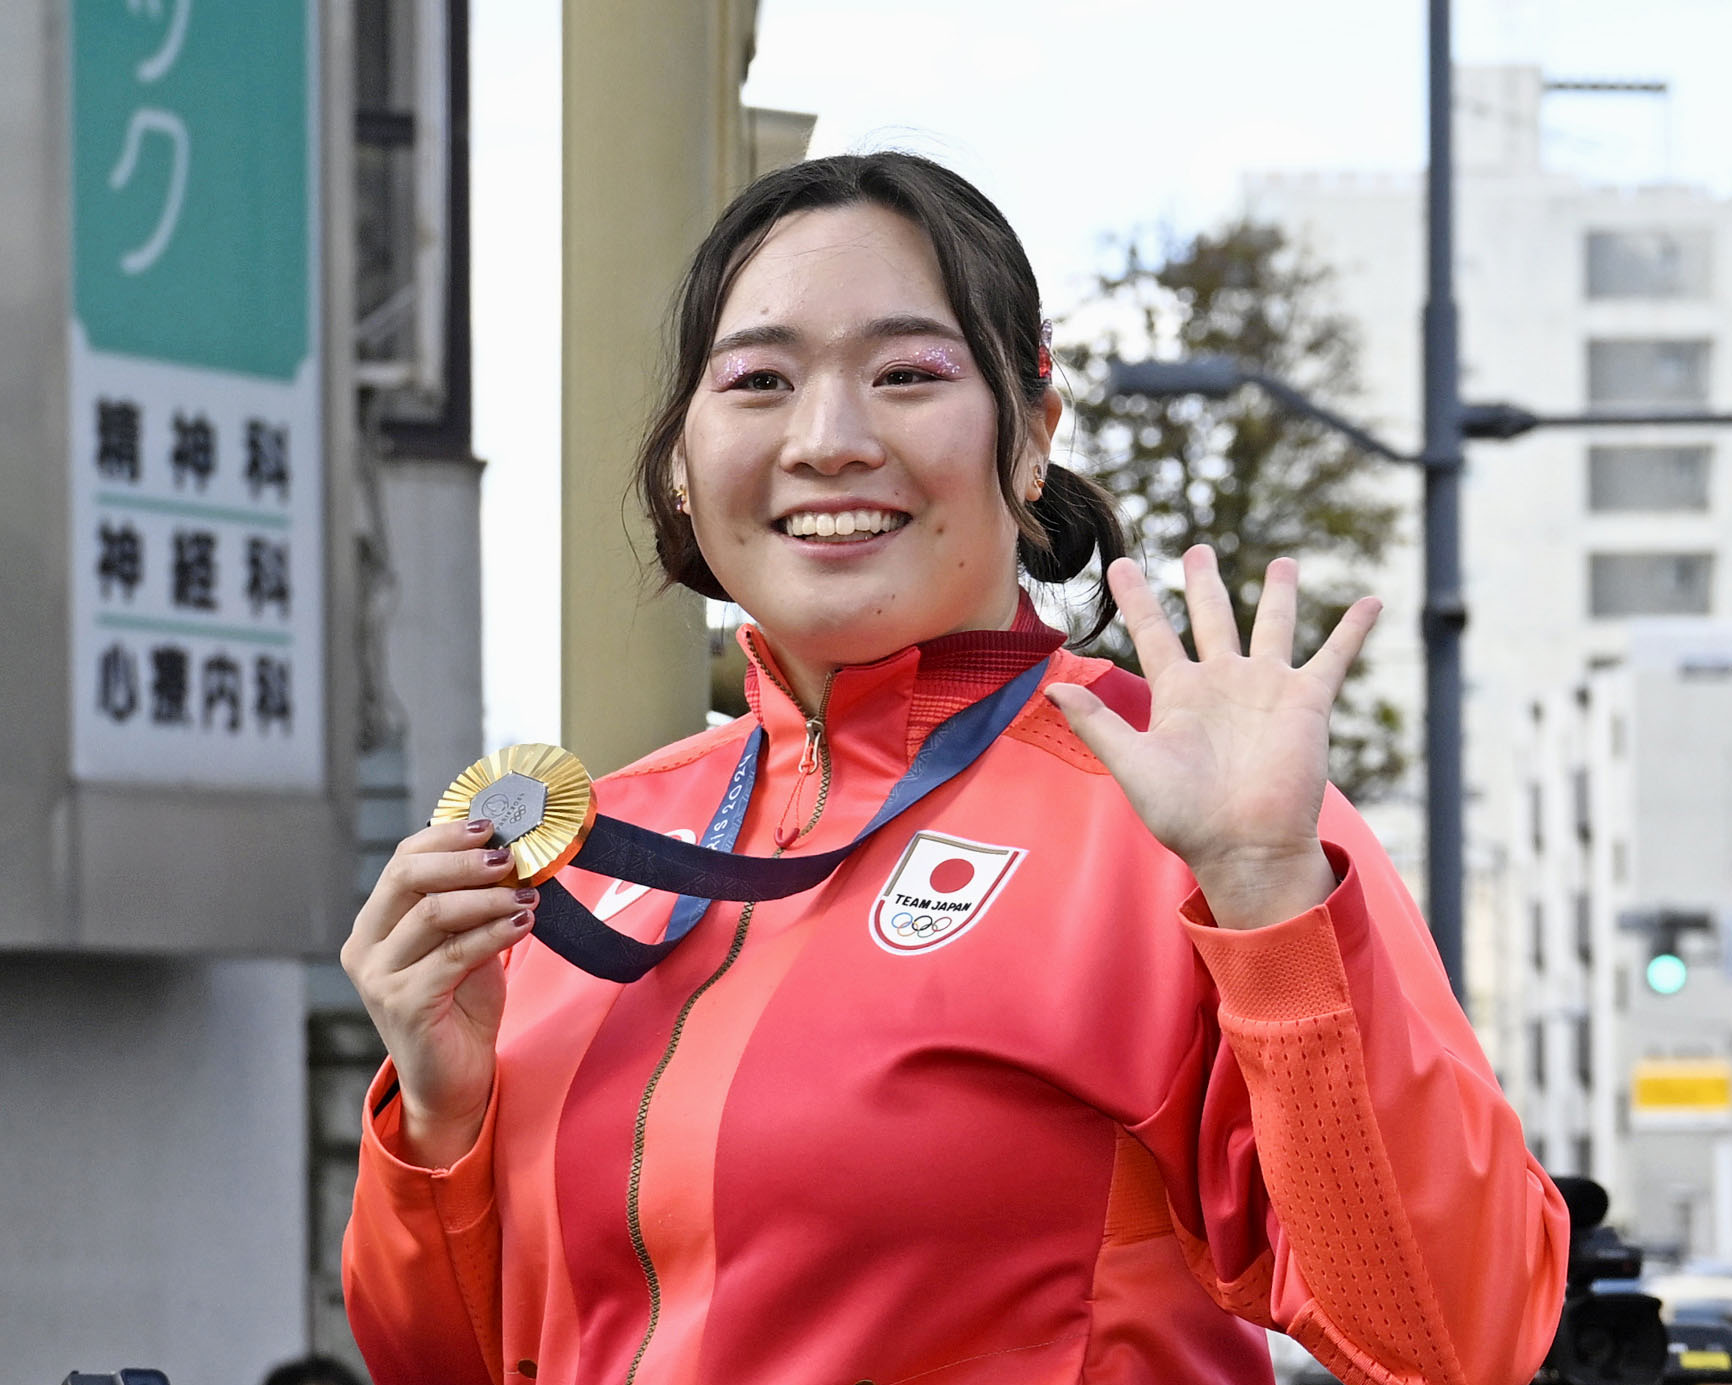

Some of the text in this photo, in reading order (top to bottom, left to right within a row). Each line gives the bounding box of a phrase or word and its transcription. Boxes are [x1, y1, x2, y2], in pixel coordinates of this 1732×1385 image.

[96, 395, 291, 501] 精神科
[96, 520, 291, 619] 神経科
[98, 641, 293, 738] 心療内科
[895, 894, 972, 912] TEAM JAPAN
